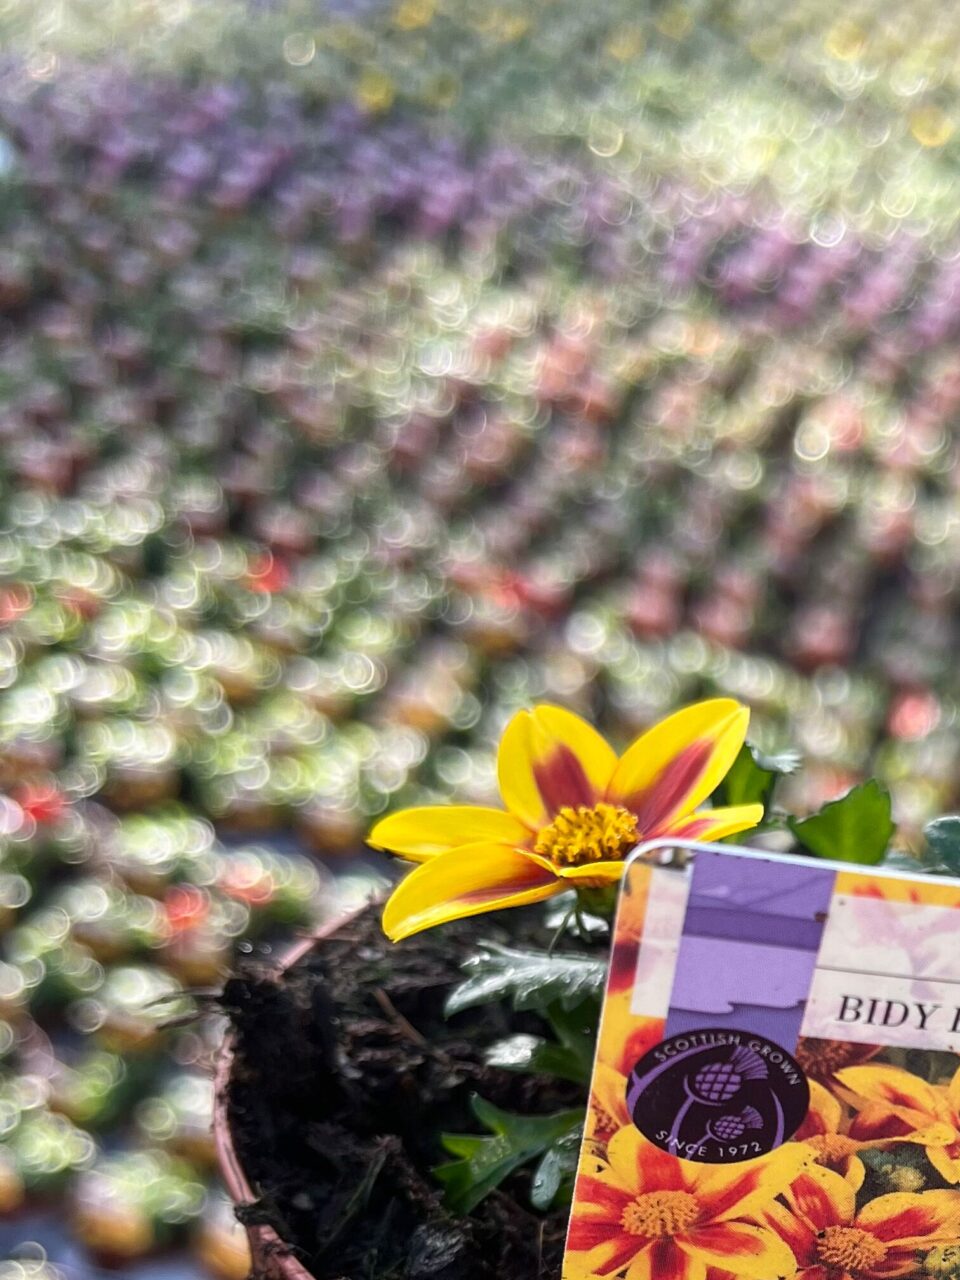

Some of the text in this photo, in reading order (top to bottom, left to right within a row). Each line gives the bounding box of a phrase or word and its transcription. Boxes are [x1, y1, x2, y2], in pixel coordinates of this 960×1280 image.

[836, 994, 941, 1029] BIDY
[654, 1033, 801, 1086] SCOTTISH GROWN
[655, 1130, 762, 1157] SINCE 1972
